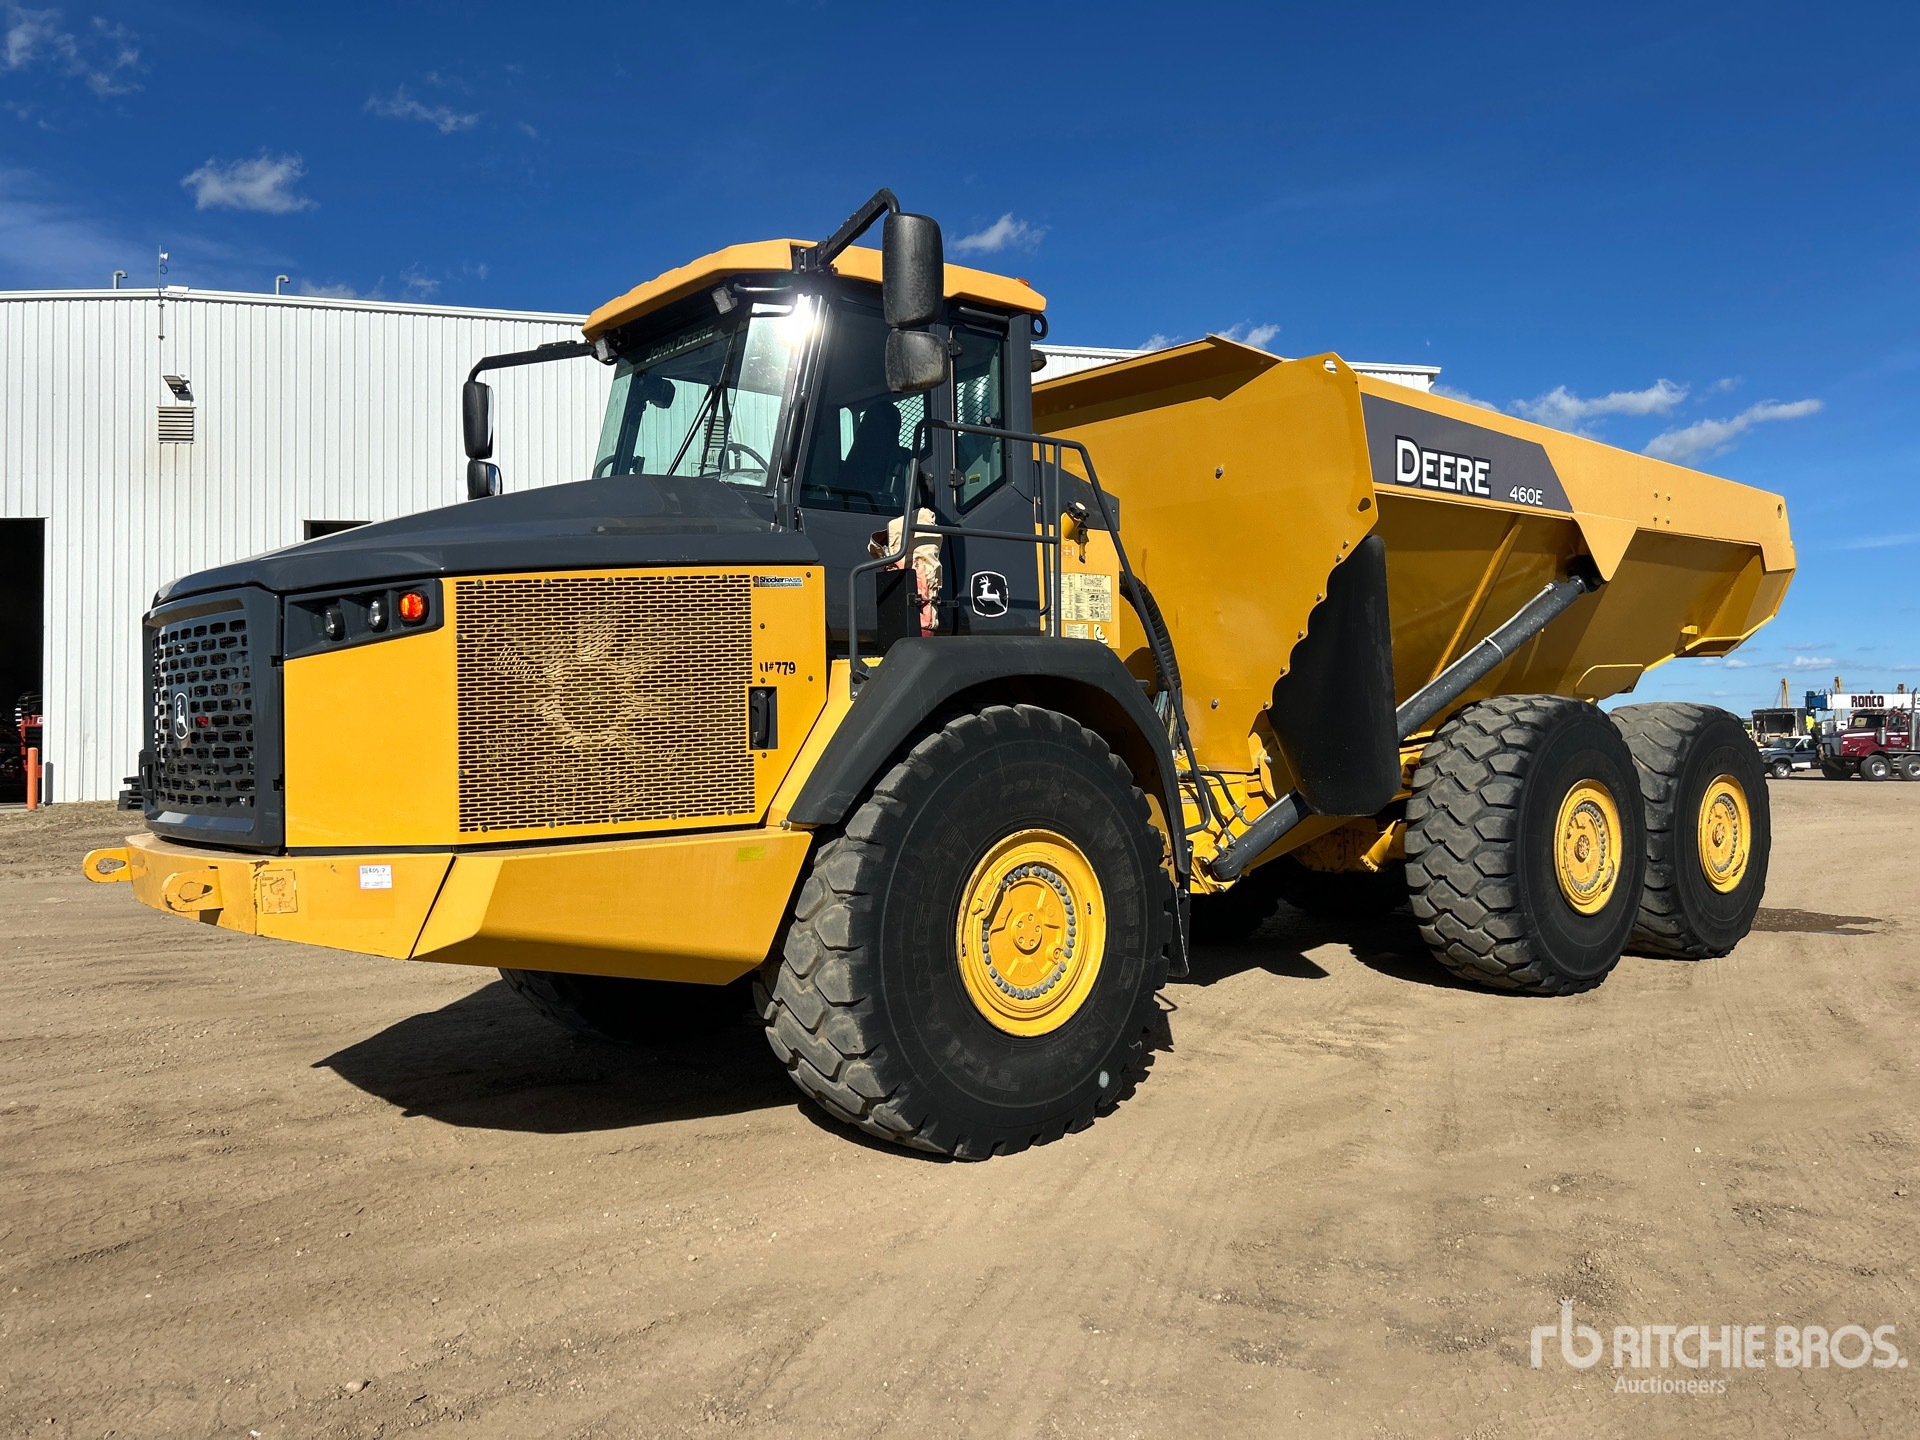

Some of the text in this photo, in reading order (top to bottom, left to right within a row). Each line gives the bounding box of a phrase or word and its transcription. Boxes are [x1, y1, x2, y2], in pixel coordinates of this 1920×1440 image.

[646, 325, 715, 362] JOHN DEERE
[1395, 436, 1491, 497] DEERE
[1509, 485, 1543, 506] 460E
[1851, 695, 1885, 708] RONCO
